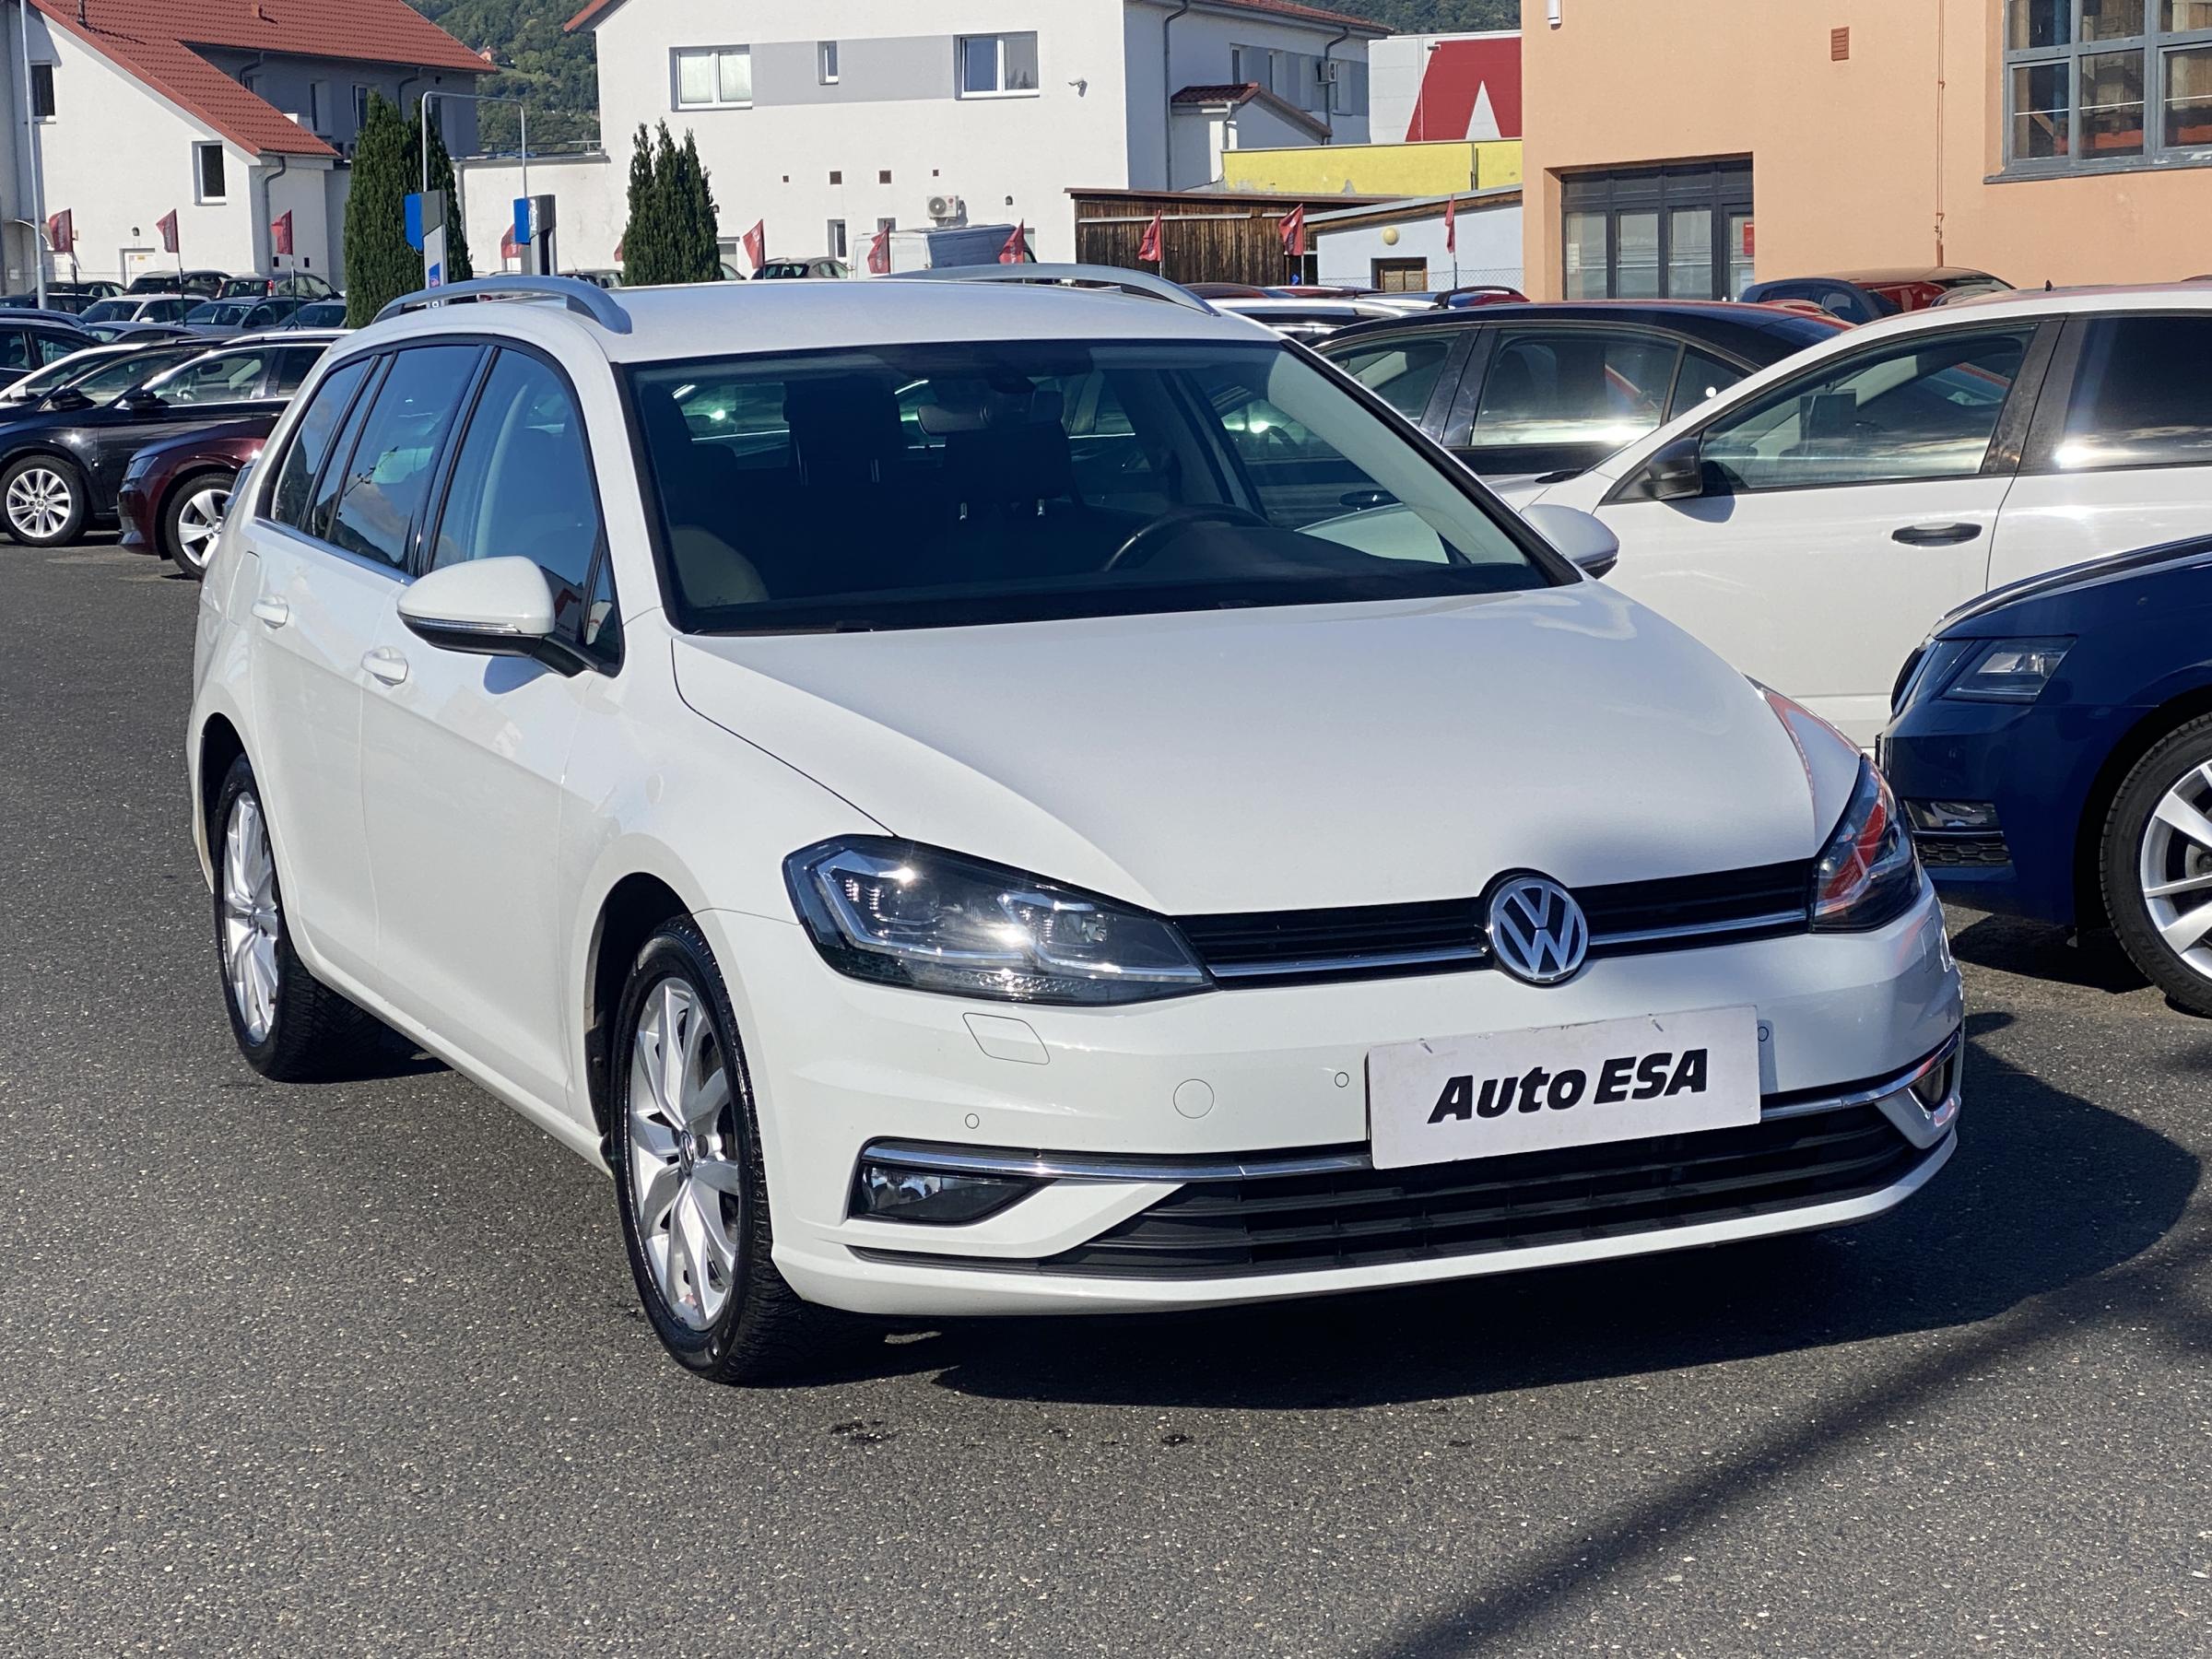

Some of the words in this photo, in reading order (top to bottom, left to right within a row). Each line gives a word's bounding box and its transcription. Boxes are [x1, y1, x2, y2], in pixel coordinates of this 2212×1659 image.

[1493, 879, 1584, 978] VW
[1427, 1066, 1587, 1124] Auto
[1593, 1048, 1708, 1105] ESA
